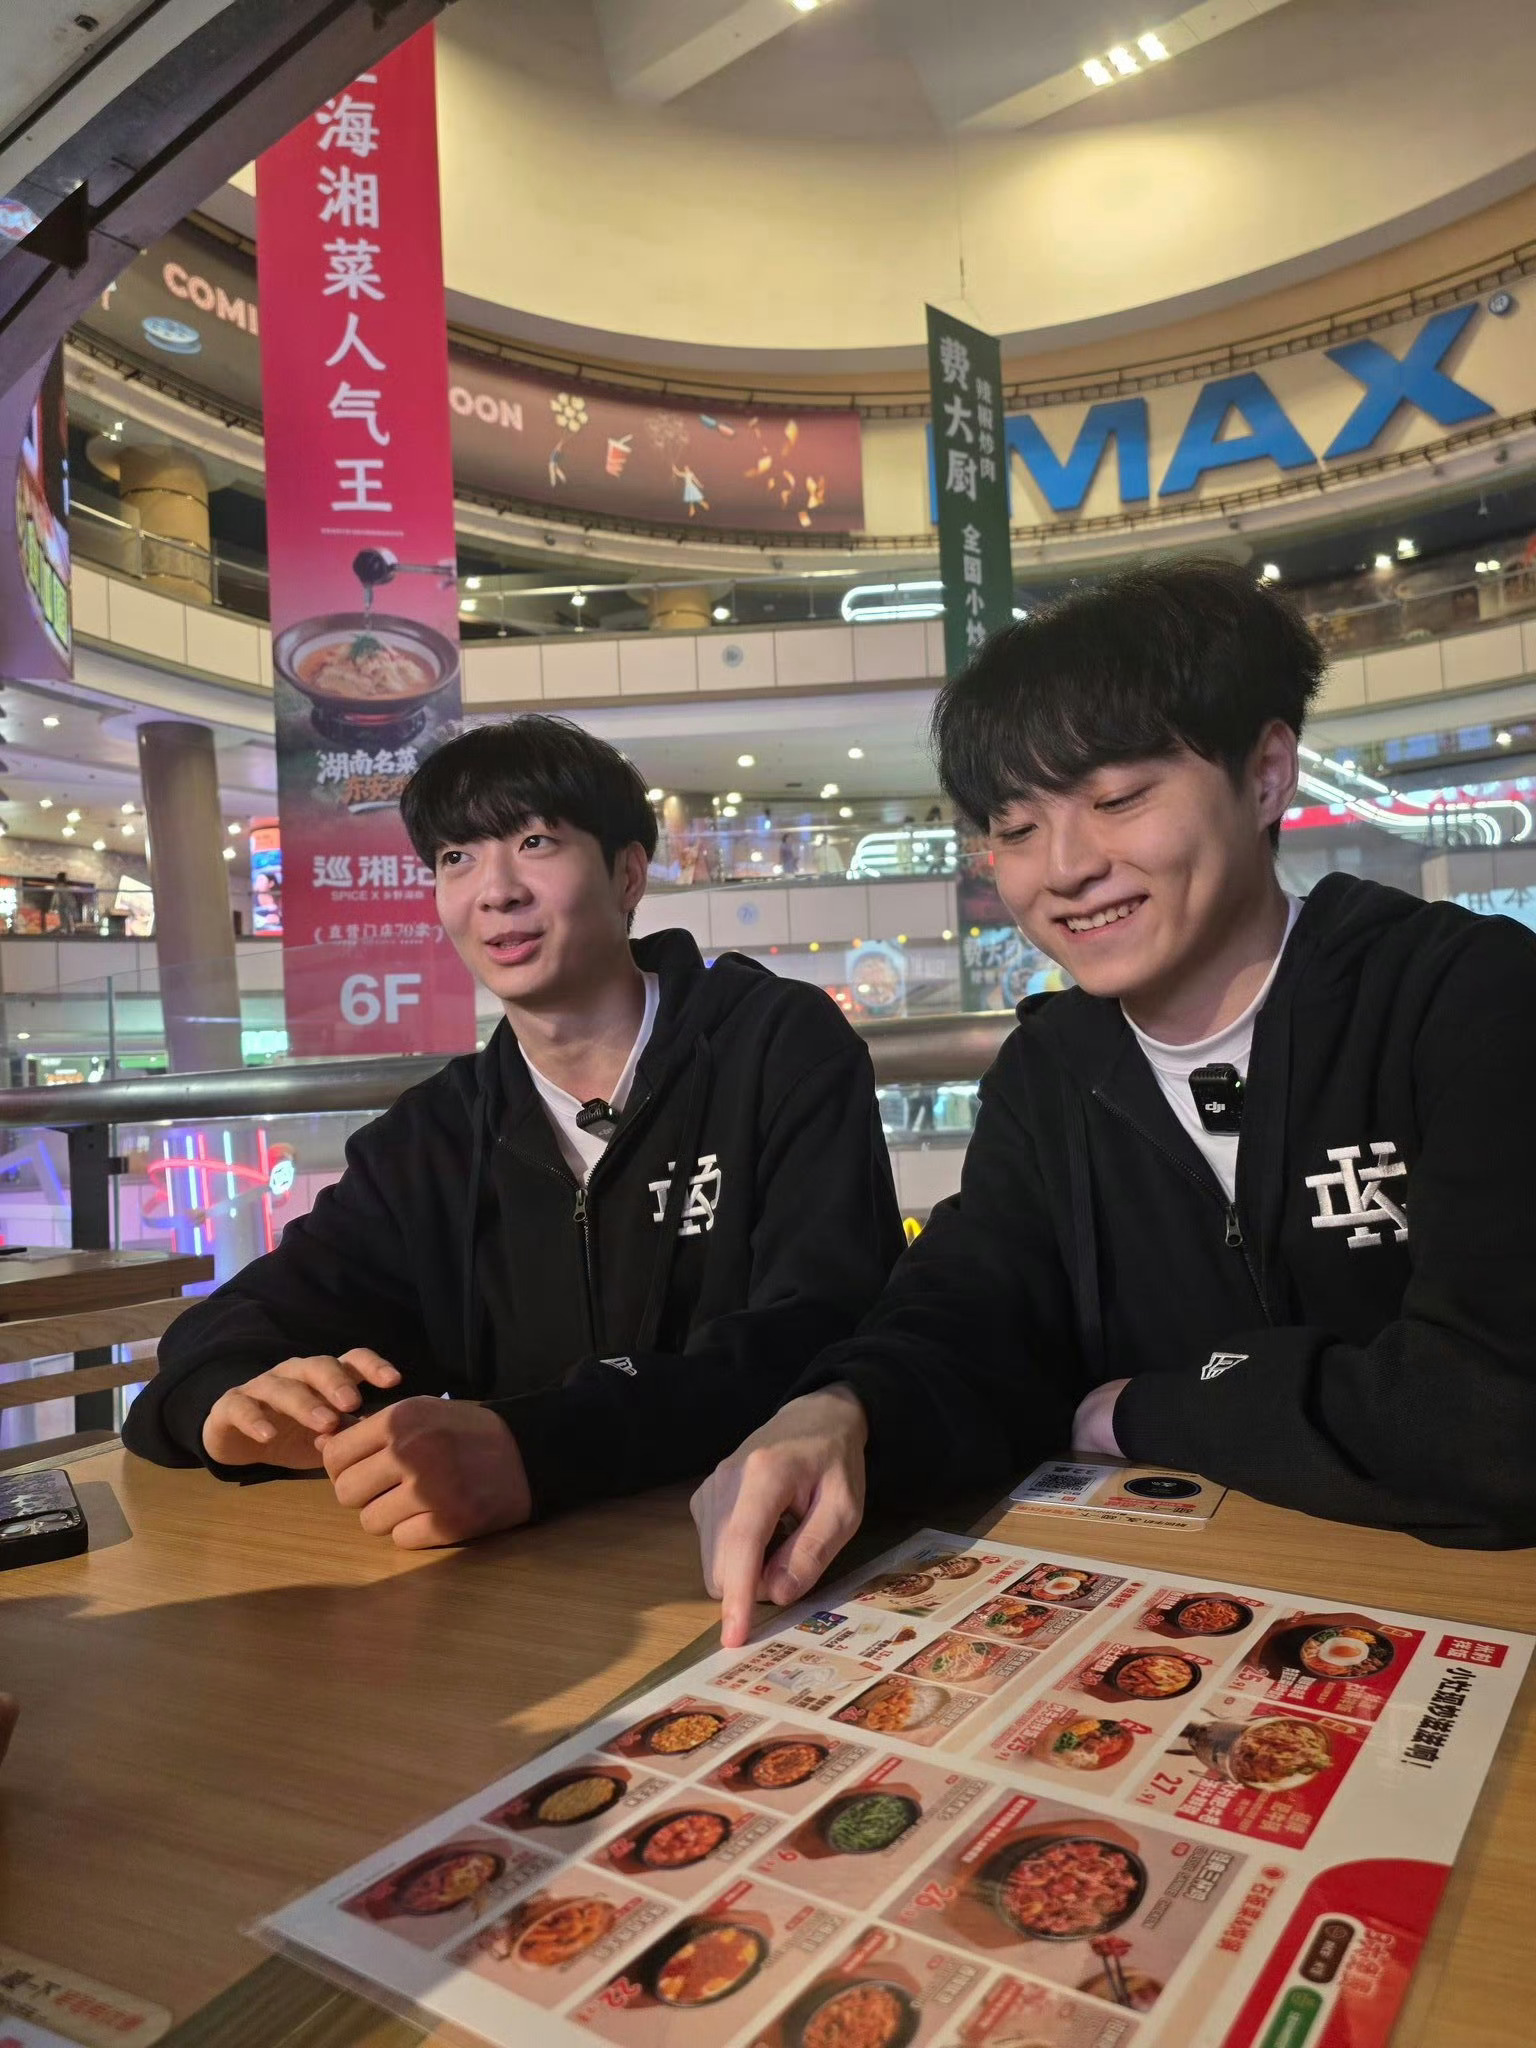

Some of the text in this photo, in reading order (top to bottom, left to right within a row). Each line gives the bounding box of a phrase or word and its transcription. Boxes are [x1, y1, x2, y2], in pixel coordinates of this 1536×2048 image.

[315, 71, 393, 513] 海湘菜人气王
[162, 263, 523, 431] COMI OON
[926, 302, 1495, 525] MAX
[939, 337, 977, 501] 费大厨
[317, 748, 418, 784] 湖南名菜
[313, 855, 437, 888] 巡湘记
[340, 974, 422, 1026] 6F
[1205, 1101, 1226, 1114] dji
[1444, 1639, 1473, 1659] 拌饭
[1468, 1643, 1496, 1663] 米村
[1400, 1667, 1477, 1769] 小灶现炒滋滋响！
[1182, 1850, 1234, 1902] 经典三杯鸡
